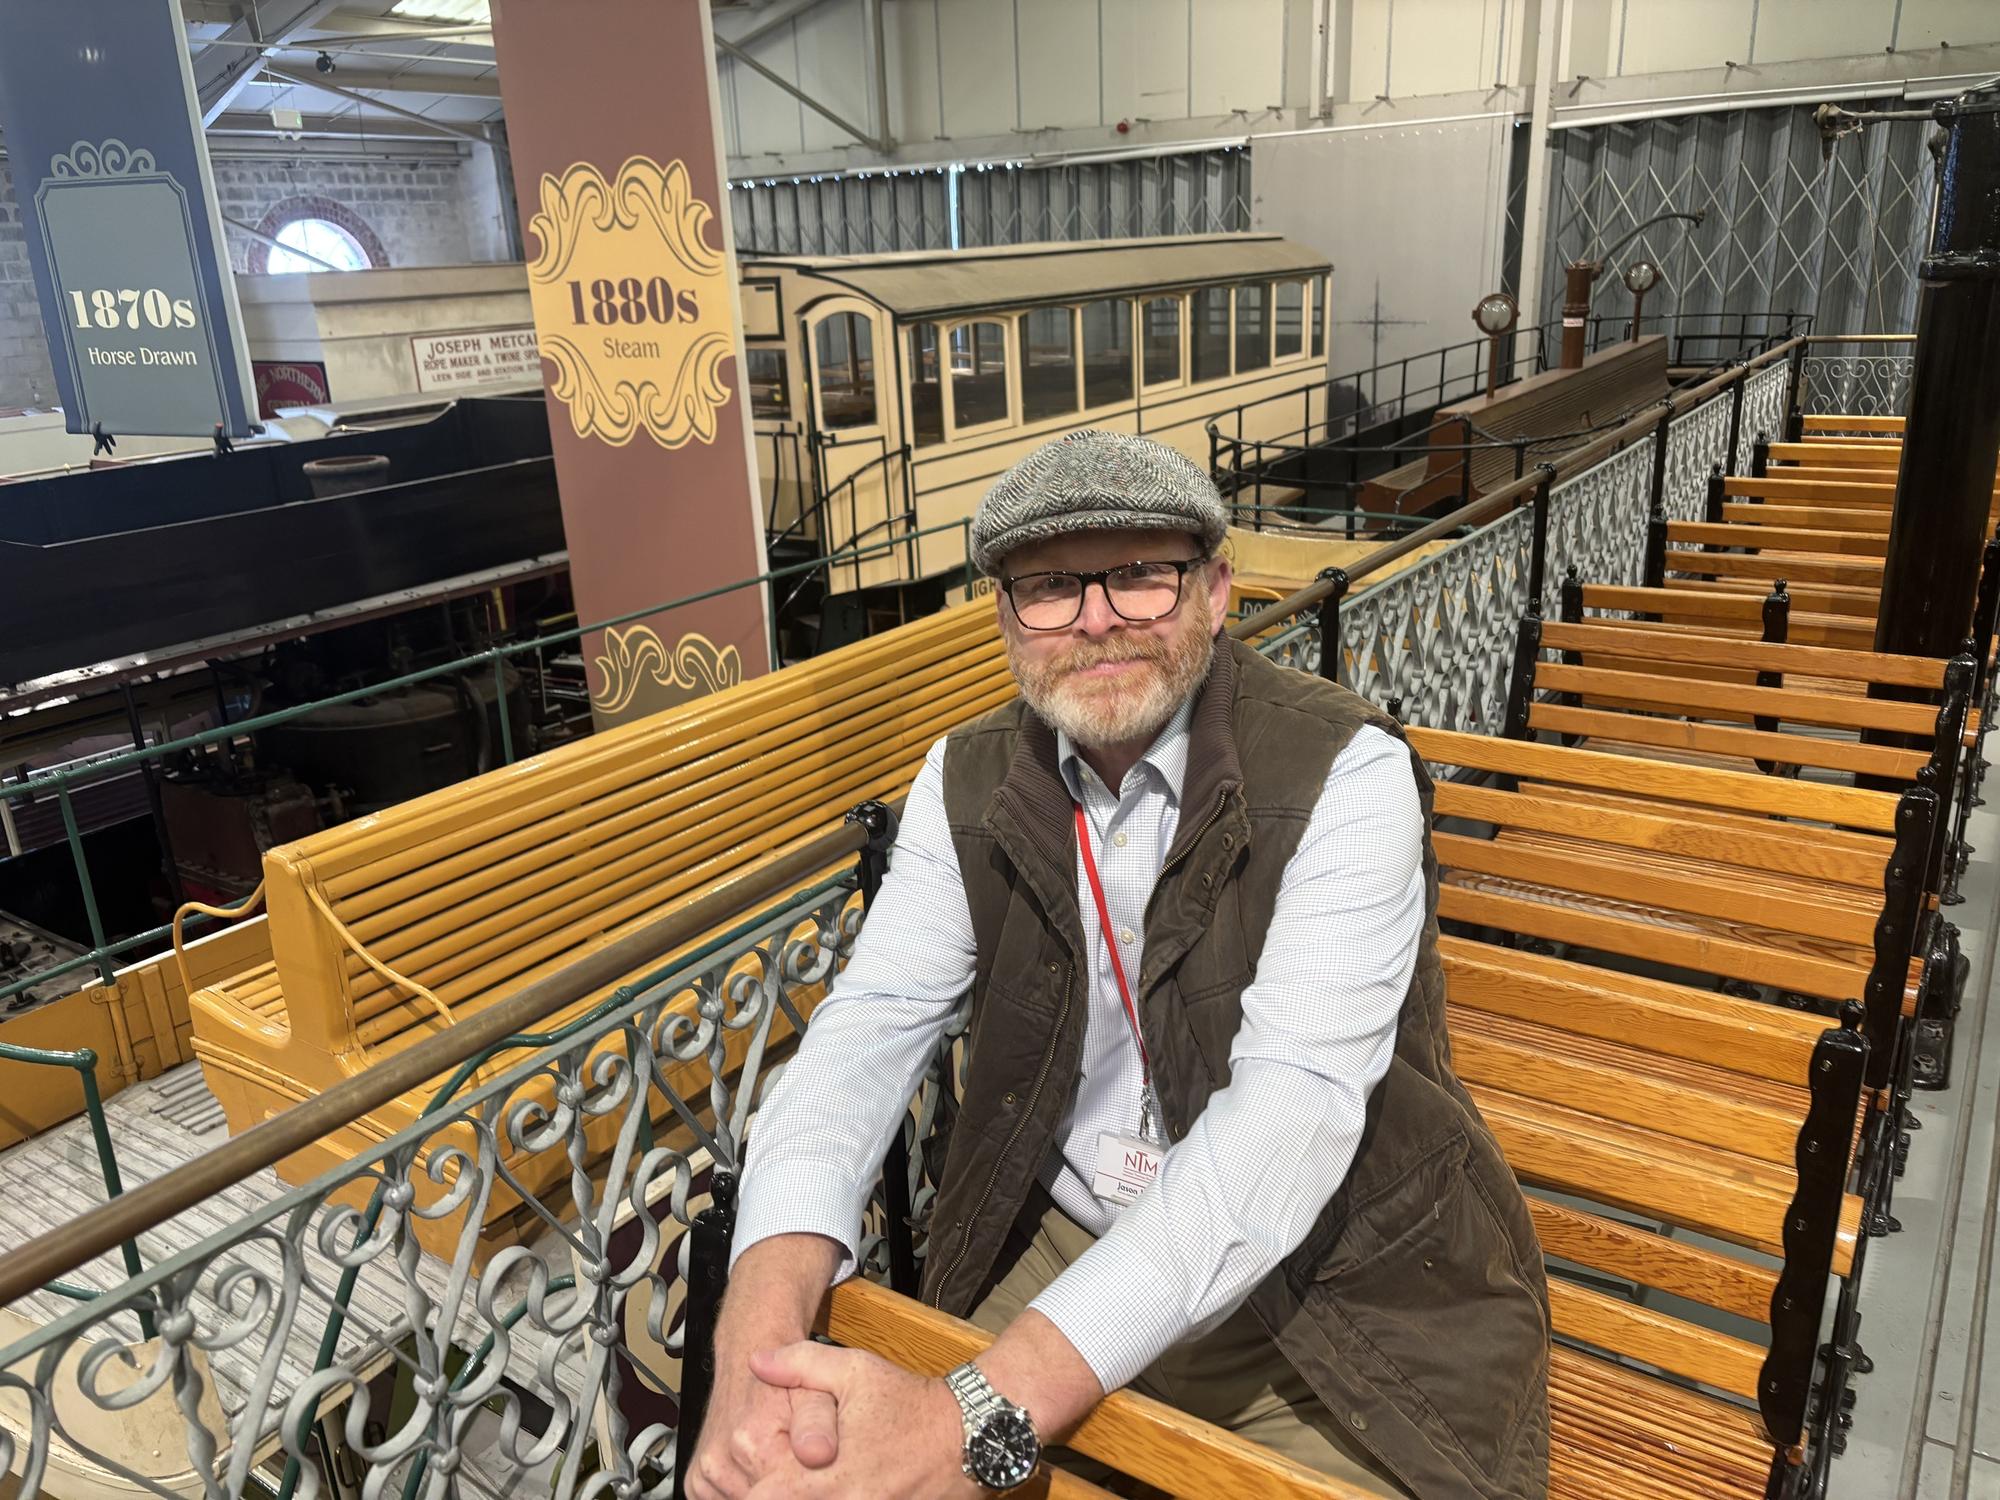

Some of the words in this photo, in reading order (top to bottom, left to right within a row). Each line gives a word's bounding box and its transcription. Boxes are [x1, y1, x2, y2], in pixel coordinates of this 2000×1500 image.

[69, 288, 196, 330] 1870s
[567, 276, 699, 326] 1880s
[88, 347, 136, 366] Horse
[139, 347, 198, 366] Drawn
[427, 339, 481, 361] JOSEPH
[603, 337, 660, 359] Steam
[423, 359, 448, 372] ROPE
[449, 356, 481, 369] MAKER
[495, 351, 521, 364] TWINE
[1124, 1150, 1158, 1176] NTM
[1117, 1182, 1138, 1195] Jason
